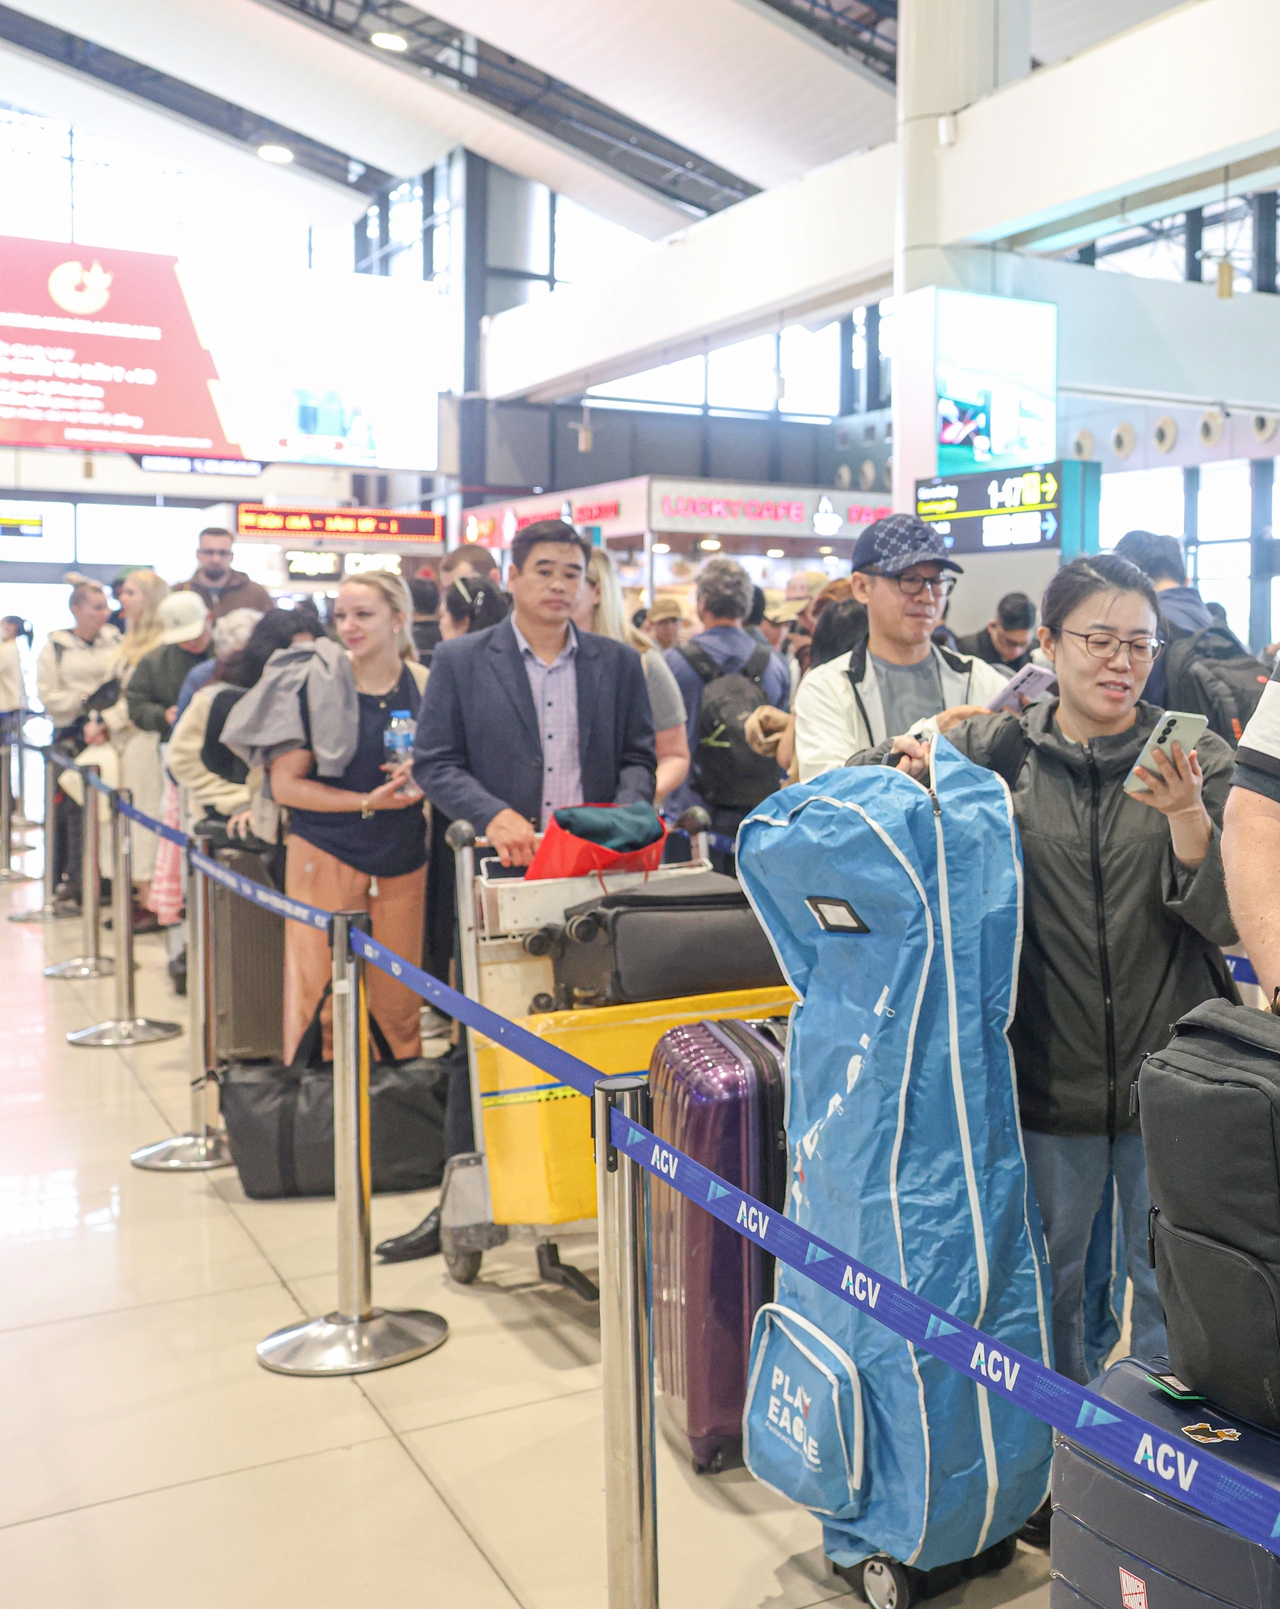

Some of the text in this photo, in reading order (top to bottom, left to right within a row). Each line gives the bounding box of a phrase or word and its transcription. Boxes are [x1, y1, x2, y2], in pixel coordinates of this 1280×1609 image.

[662, 495, 805, 523] LUCKY CAFE
[650, 1144, 679, 1180] ACV
[736, 1200, 770, 1240] ACV
[840, 1264, 881, 1309] ACV
[970, 1341, 1021, 1392] ACV
[1133, 1432, 1199, 1492] ACV
